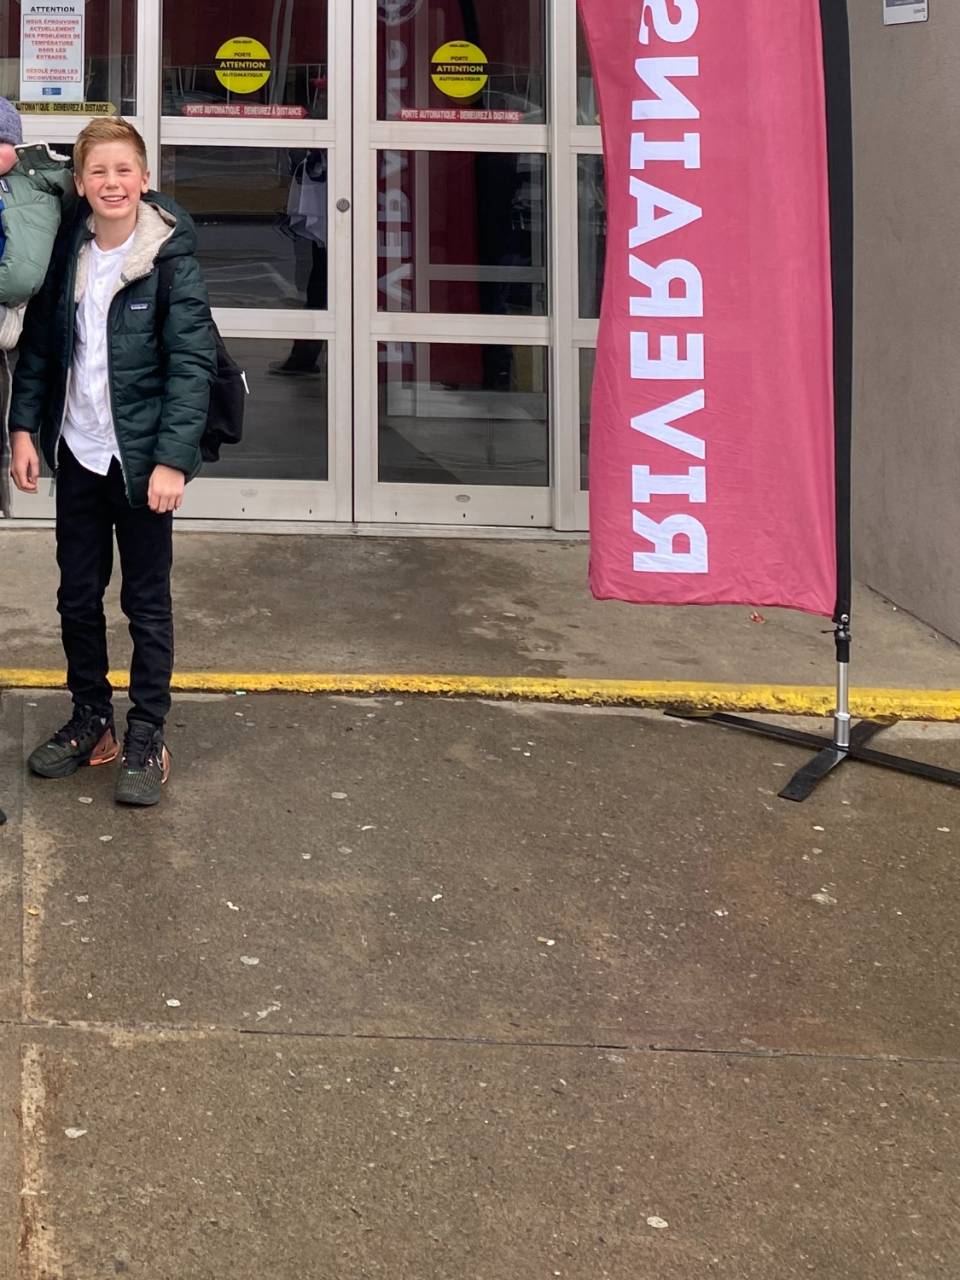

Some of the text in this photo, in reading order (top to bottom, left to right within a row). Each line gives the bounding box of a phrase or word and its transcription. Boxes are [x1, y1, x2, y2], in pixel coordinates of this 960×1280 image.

[220, 61, 266, 69] ATTENTION
[85, 103, 109, 112] DISTANCE
[187, 105, 203, 114] PORTE
[204, 105, 241, 114] AUTOMATIQUE
[277, 107, 301, 116] DISTANCE
[401, 109, 419, 118] PORTE
[419, 110, 456, 119] AUTOMATIQUE
[493, 111, 519, 120] DISTANCE
